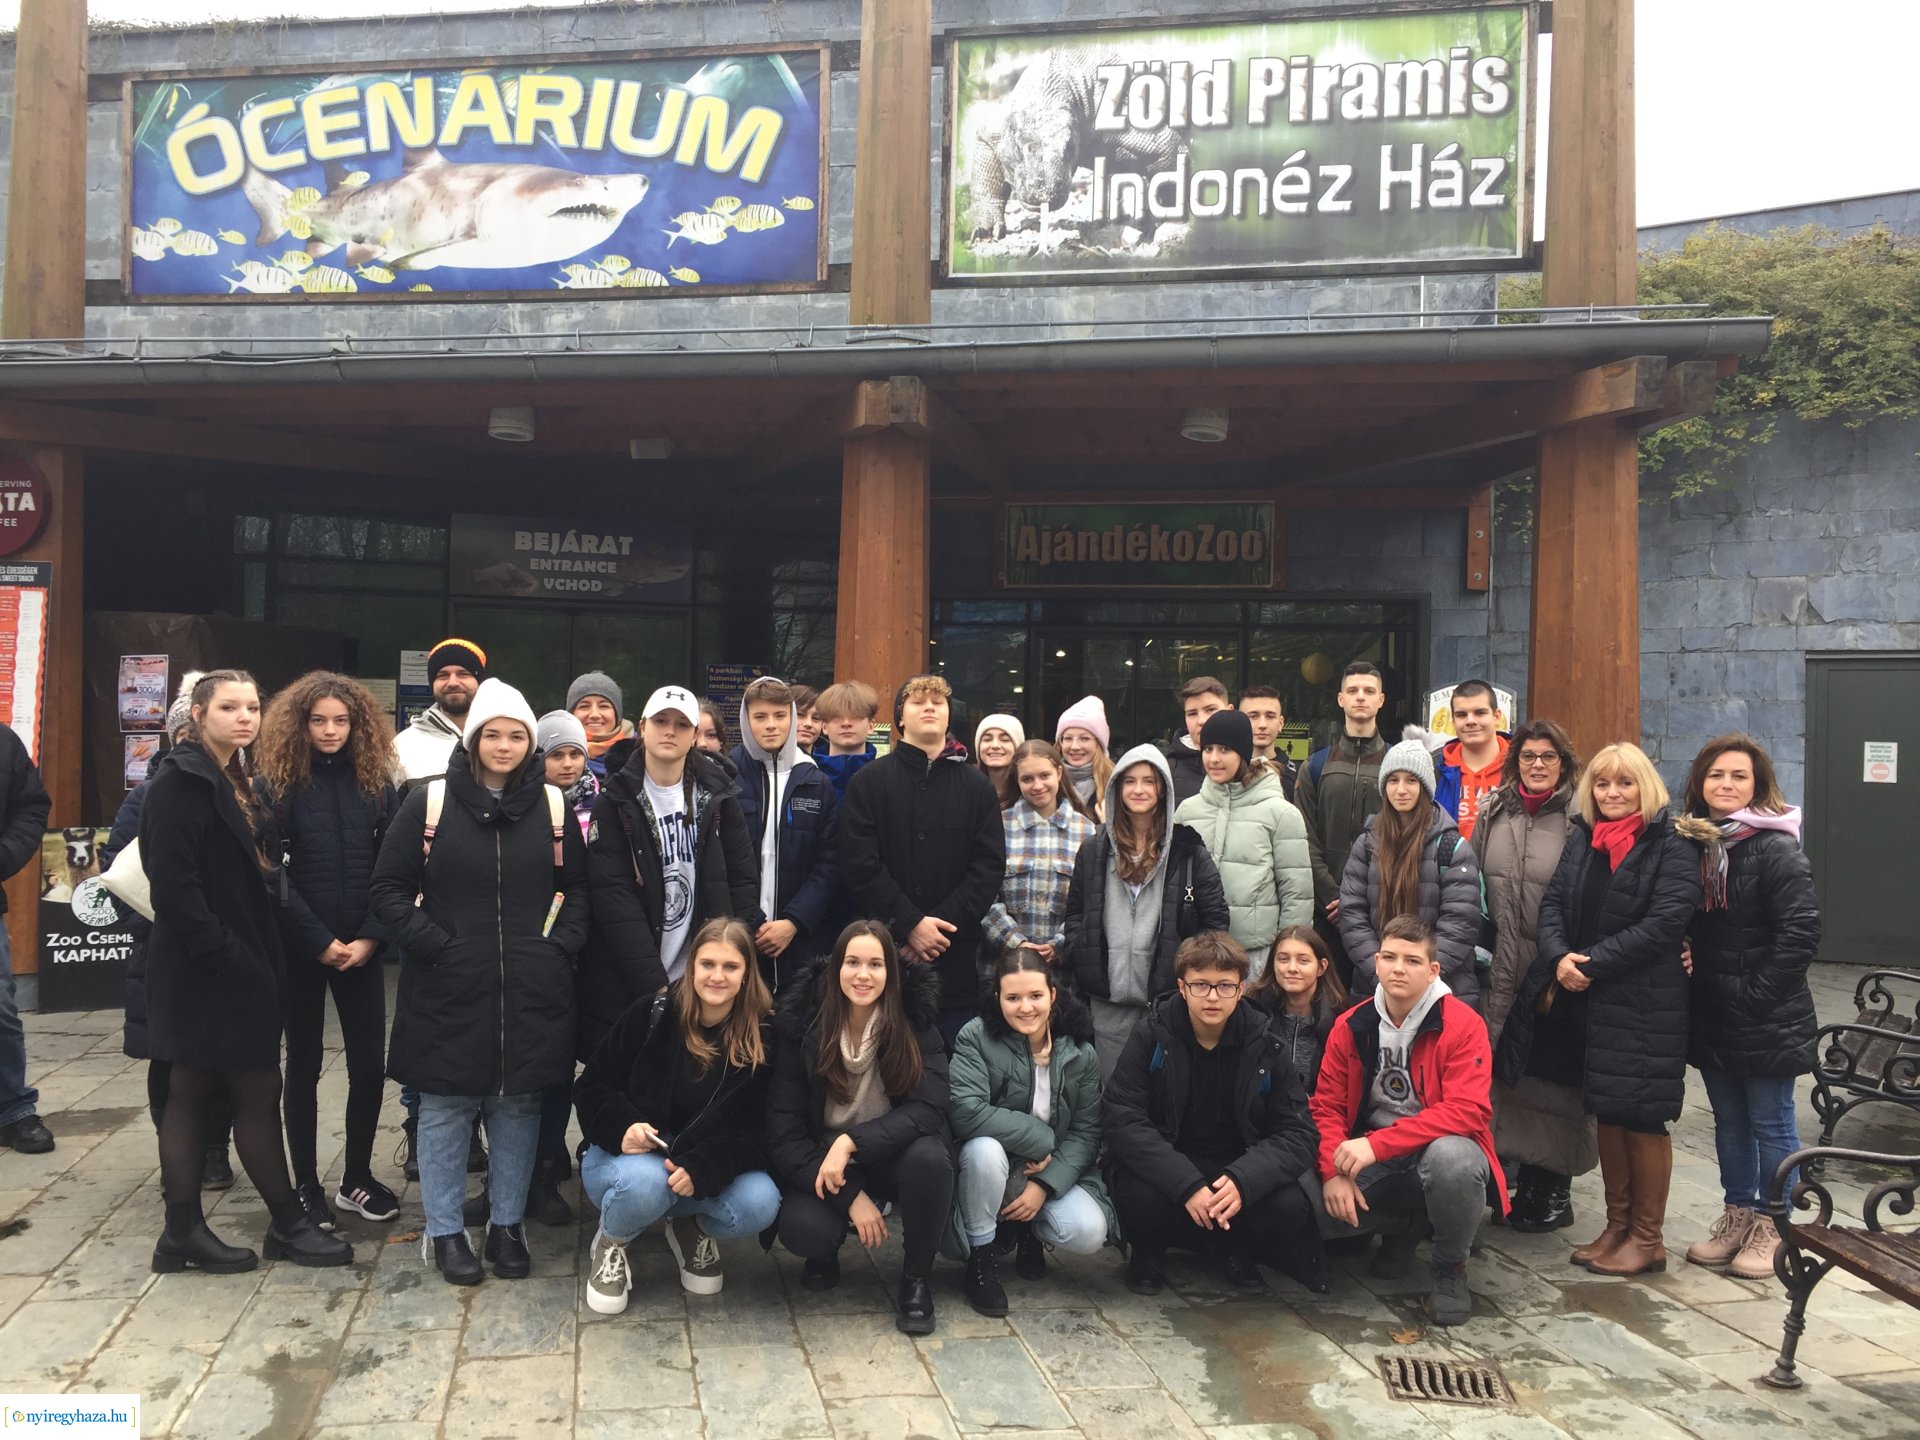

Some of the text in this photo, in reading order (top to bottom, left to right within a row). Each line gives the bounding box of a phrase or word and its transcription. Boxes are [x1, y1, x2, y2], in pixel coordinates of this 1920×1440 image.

[1095, 47, 1510, 130] Zöld Piramis
[1092, 142, 1505, 221] Indonéz Ház
[515, 529, 633, 555] BEJÁRAT
[1016, 523, 1264, 566] AjándékoZoo
[530, 558, 617, 573] ENTRANCE
[543, 578, 602, 592] VCHOD
[53, 947, 133, 963] KAPHAT
